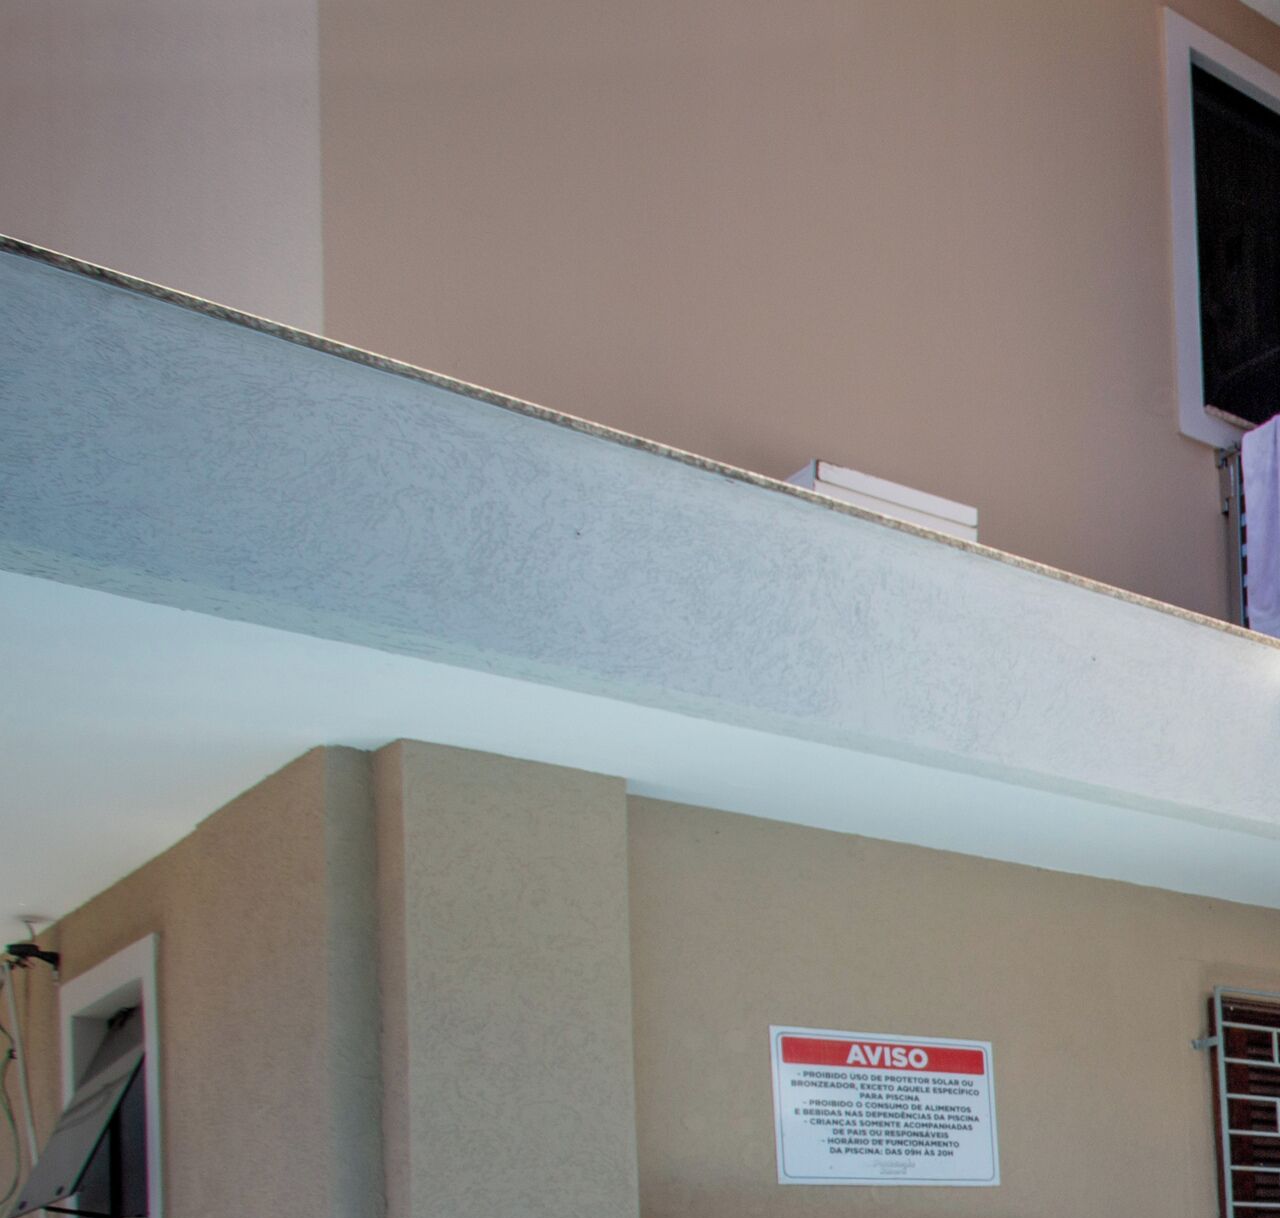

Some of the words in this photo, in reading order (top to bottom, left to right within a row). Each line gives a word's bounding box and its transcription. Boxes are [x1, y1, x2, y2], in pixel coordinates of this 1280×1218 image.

[846, 1044, 928, 1068] AVISO
[803, 1071, 848, 1080] PROIBIDO
[850, 1073, 868, 1081] USO
[871, 1074, 882, 1082] DE
[884, 1075, 929, 1084] PROTETOR
[932, 1078, 959, 1086] SOLAR
[791, 1080, 858, 1090] BRONZEADOR,
[860, 1083, 894, 1091] EXCETO
[897, 1085, 930, 1093] AQUELE
[933, 1087, 980, 1096] ESPECÍFICO
[886, 1094, 920, 1102] PISCINA
[809, 1099, 853, 1108] PROIBIDO
[865, 1102, 909, 1110] CONSUMO
[925, 1104, 971, 1113] ALIMENTOS
[803, 1108, 842, 1116] BEBIDAS
[947, 1114, 979, 1122] PISCINA
[833, 1128, 845, 1136] DE
[859, 1120, 901, 1128] SOMENTE
[904, 1122, 973, 1131] ACOMPANHADAS
[886, 1139, 960, 1148] FUNCIONAMENTO
